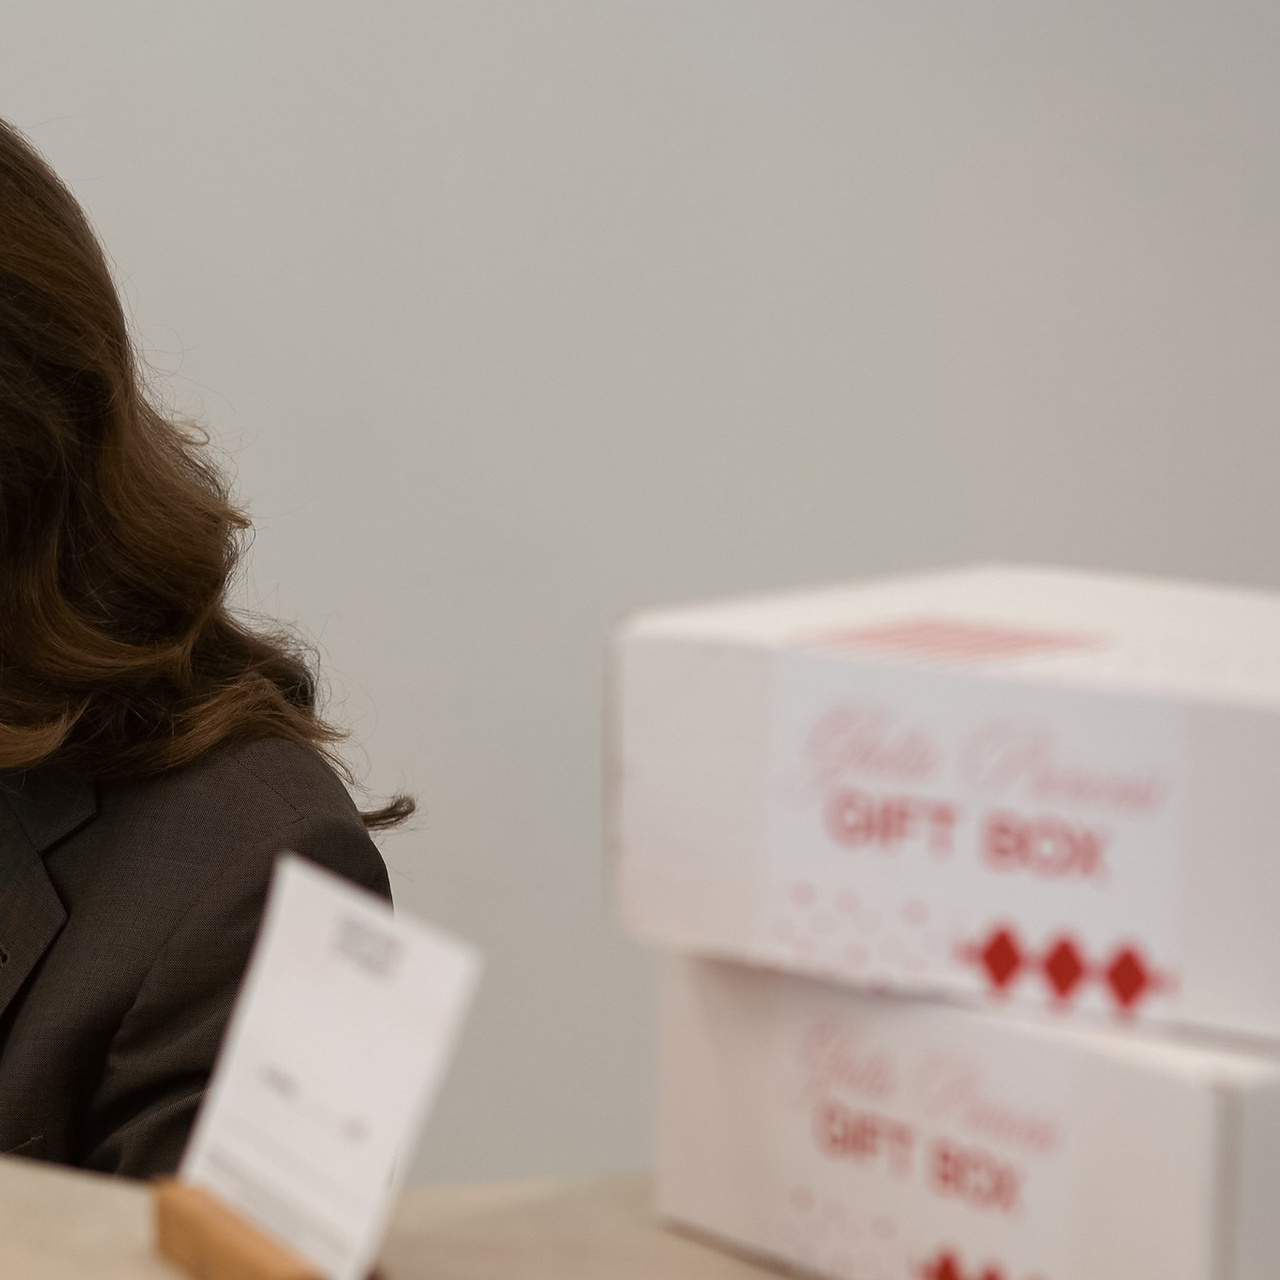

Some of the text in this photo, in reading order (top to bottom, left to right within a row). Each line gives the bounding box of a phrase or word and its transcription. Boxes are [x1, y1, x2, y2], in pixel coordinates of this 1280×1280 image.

[822, 786, 1113, 887] GIFT BOX
[812, 1097, 1025, 1216] GIFT BOX
